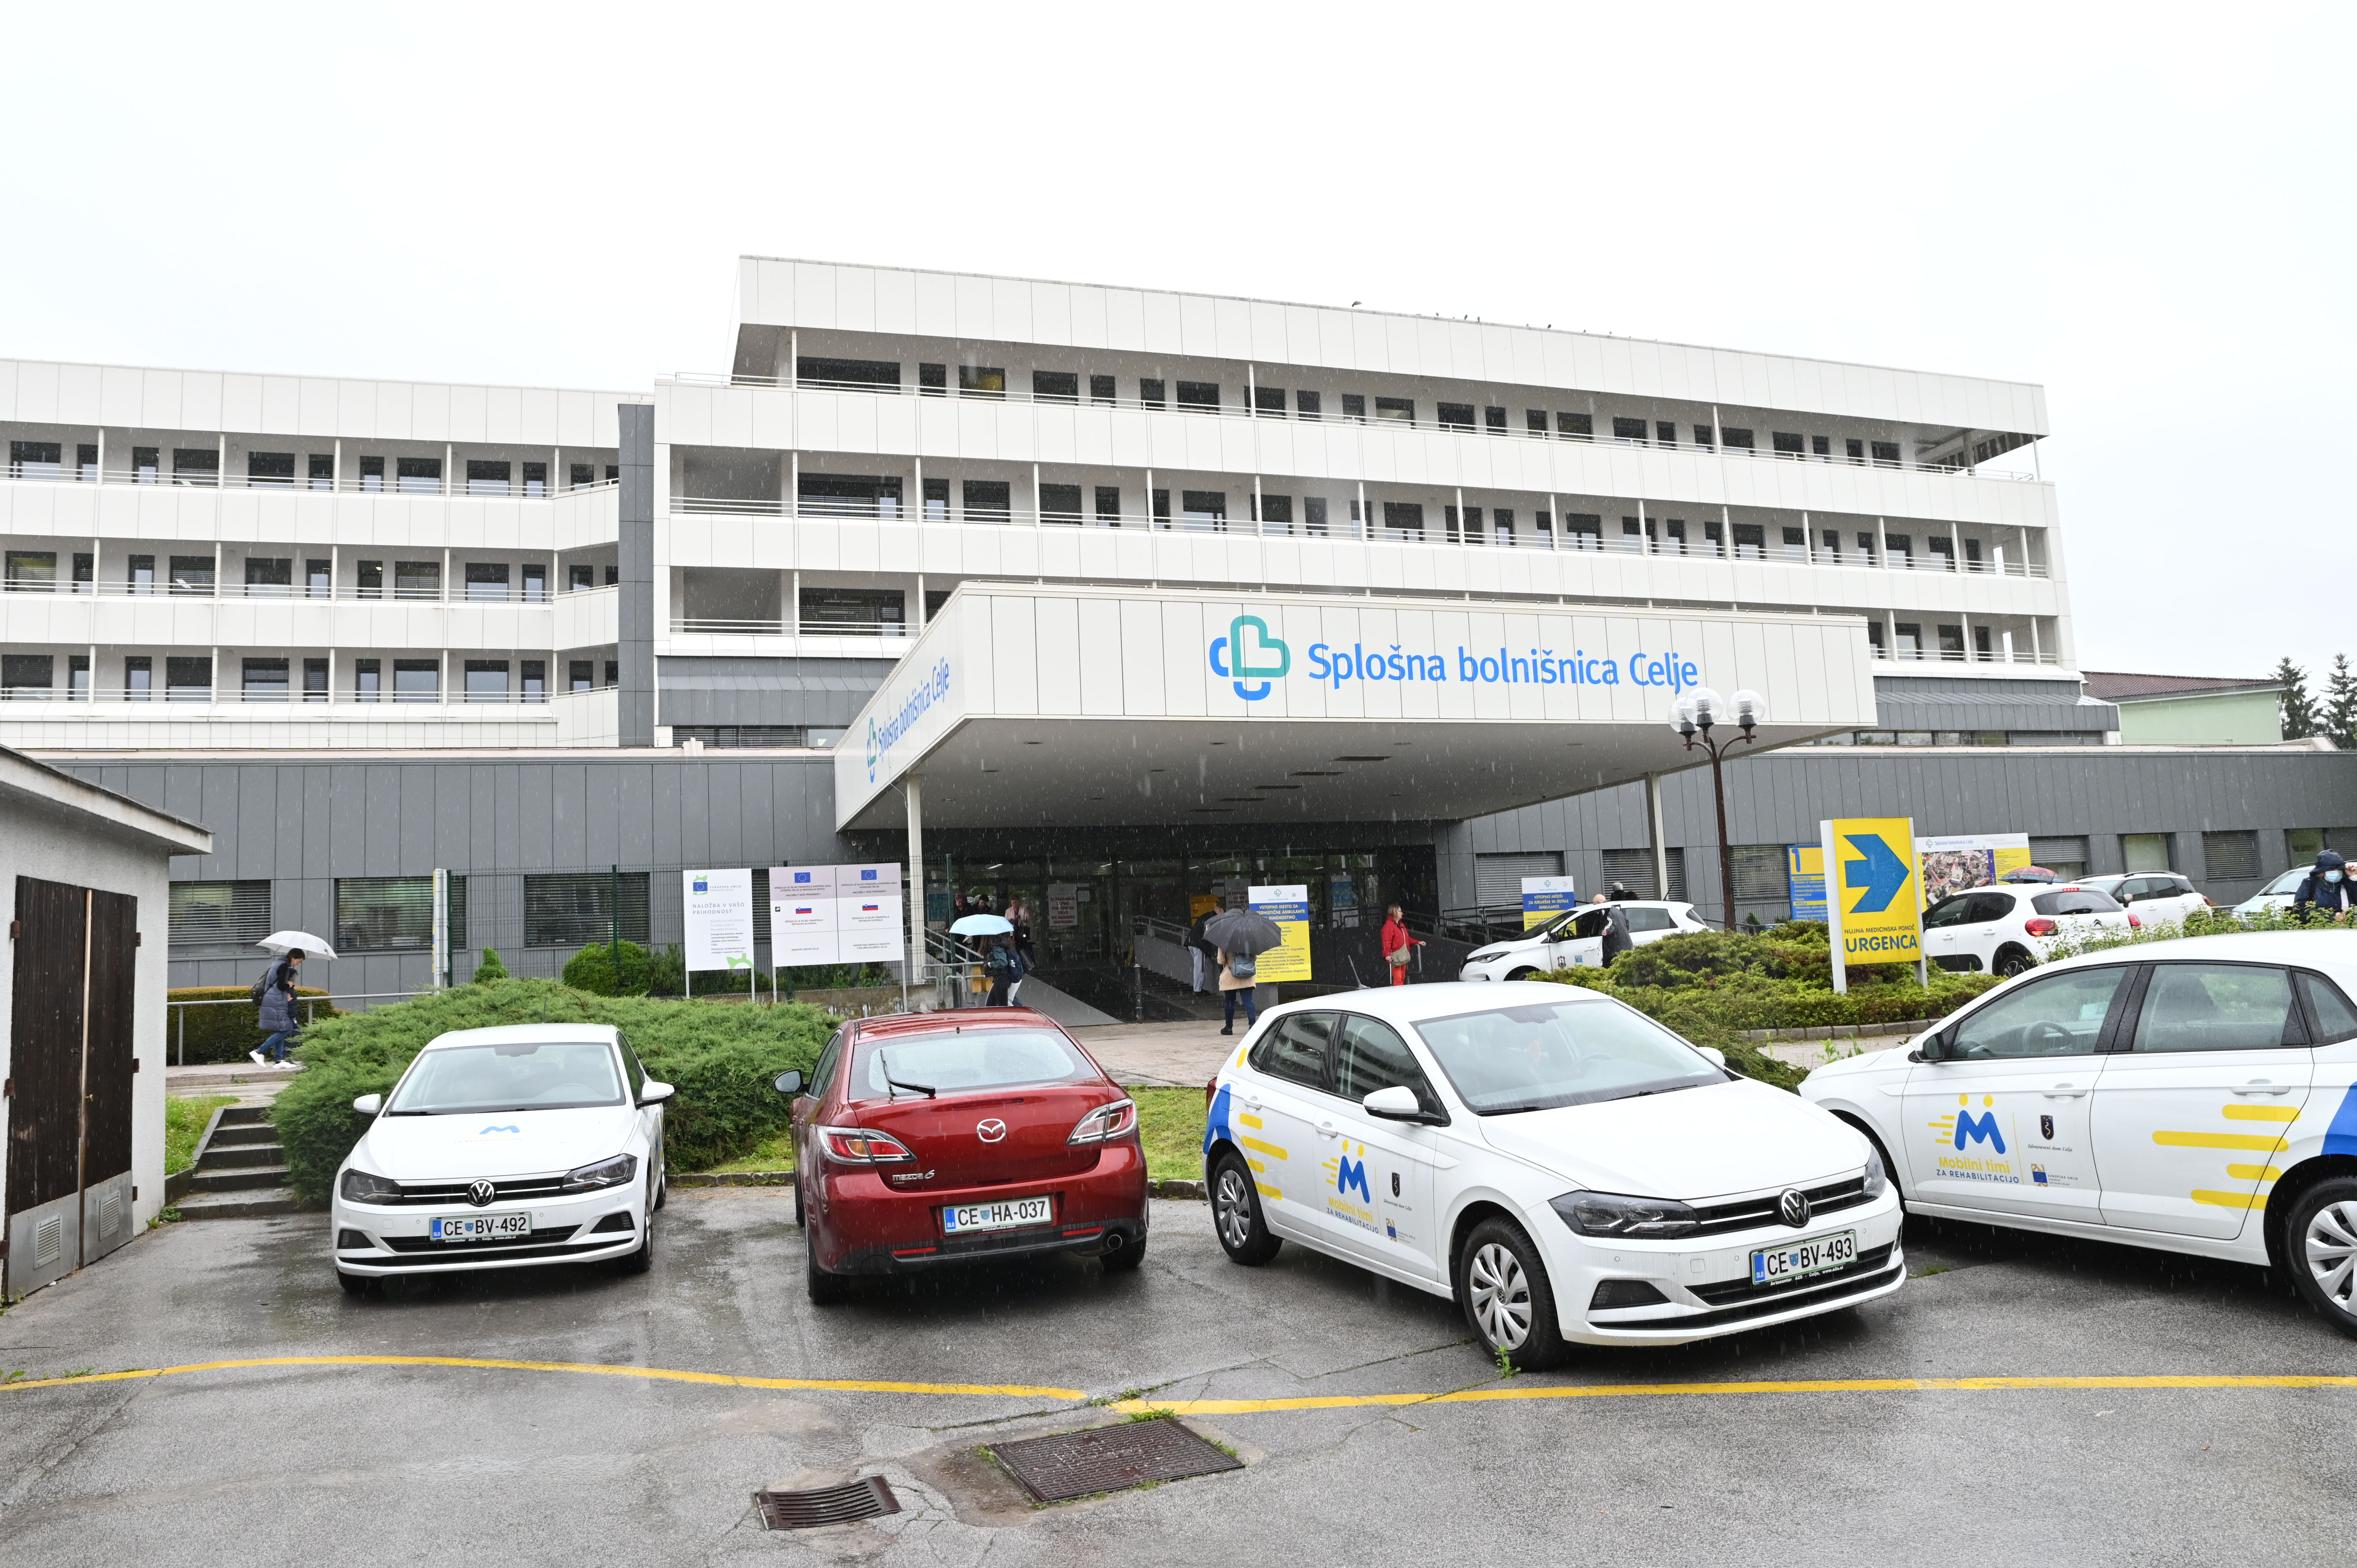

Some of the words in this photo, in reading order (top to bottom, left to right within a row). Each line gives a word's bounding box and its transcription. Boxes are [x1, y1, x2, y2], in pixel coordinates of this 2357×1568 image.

[1308, 644, 1445, 689] Splošna
[1458, 646, 1619, 685] bolnišnica
[1629, 652, 1698, 694] Celje
[879, 714, 898, 763] Splošna
[900, 680, 930, 736] bolnišnica
[932, 656, 949, 703] Celje
[1792, 848, 1801, 872] 1
[1846, 934, 1917, 952] URGENCA
[1938, 1157, 1983, 1171] Mobilni
[1986, 1159, 2011, 1174] timi
[1950, 1170, 2019, 1183] REHABILITACIJO
[958, 1208, 979, 1226] CE
[991, 1200, 1046, 1222] HA-037
[1329, 1196, 1356, 1216] Mobilni
[1357, 1207, 1373, 1223] timi
[444, 1221, 463, 1236] CE
[475, 1217, 526, 1234] BV-492
[1335, 1210, 1379, 1234] REHABILITACIJO
[1767, 1251, 1788, 1275] CE
[1800, 1237, 1852, 1268] BV-493
[1770, 1278, 1792, 1286] Avtocenter
